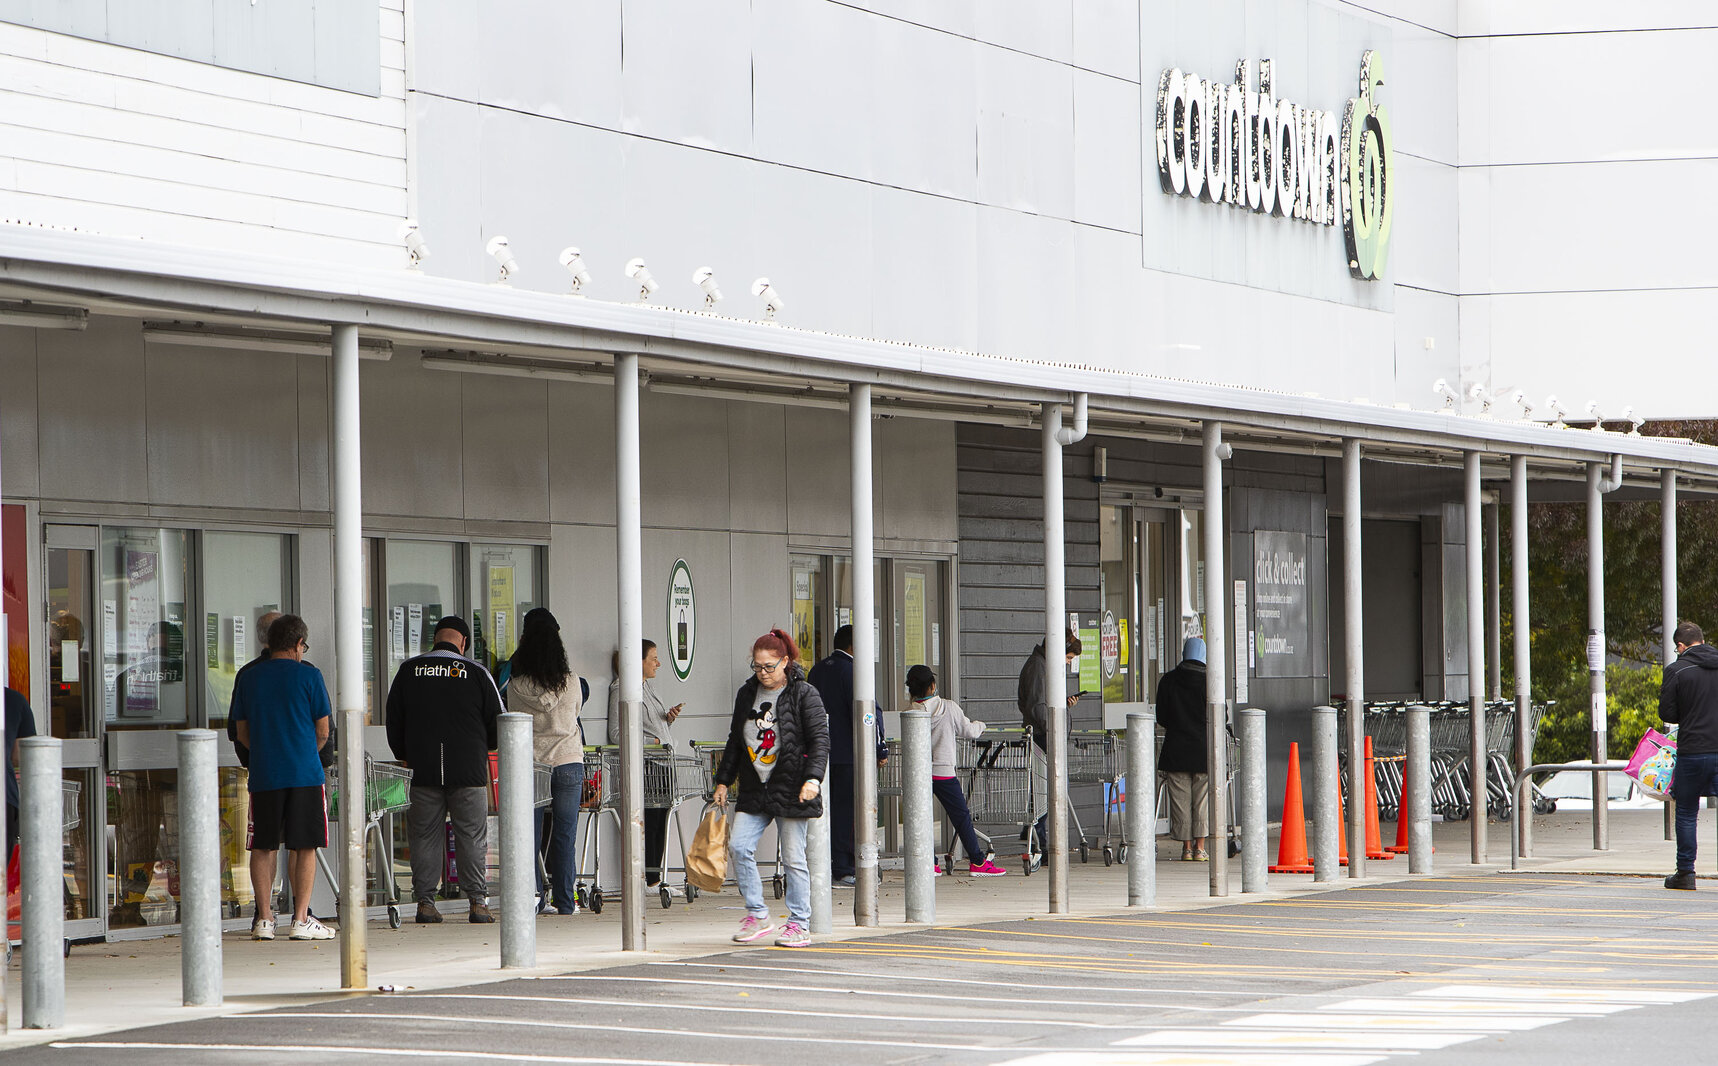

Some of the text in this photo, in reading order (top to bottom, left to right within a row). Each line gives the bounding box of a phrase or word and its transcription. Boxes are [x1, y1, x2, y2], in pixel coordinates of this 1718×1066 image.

[1157, 59, 1339, 226] countdown
[1256, 550, 1305, 586] click & collect
[1102, 635, 1118, 657] FREE
[414, 664, 468, 679] triathlon
